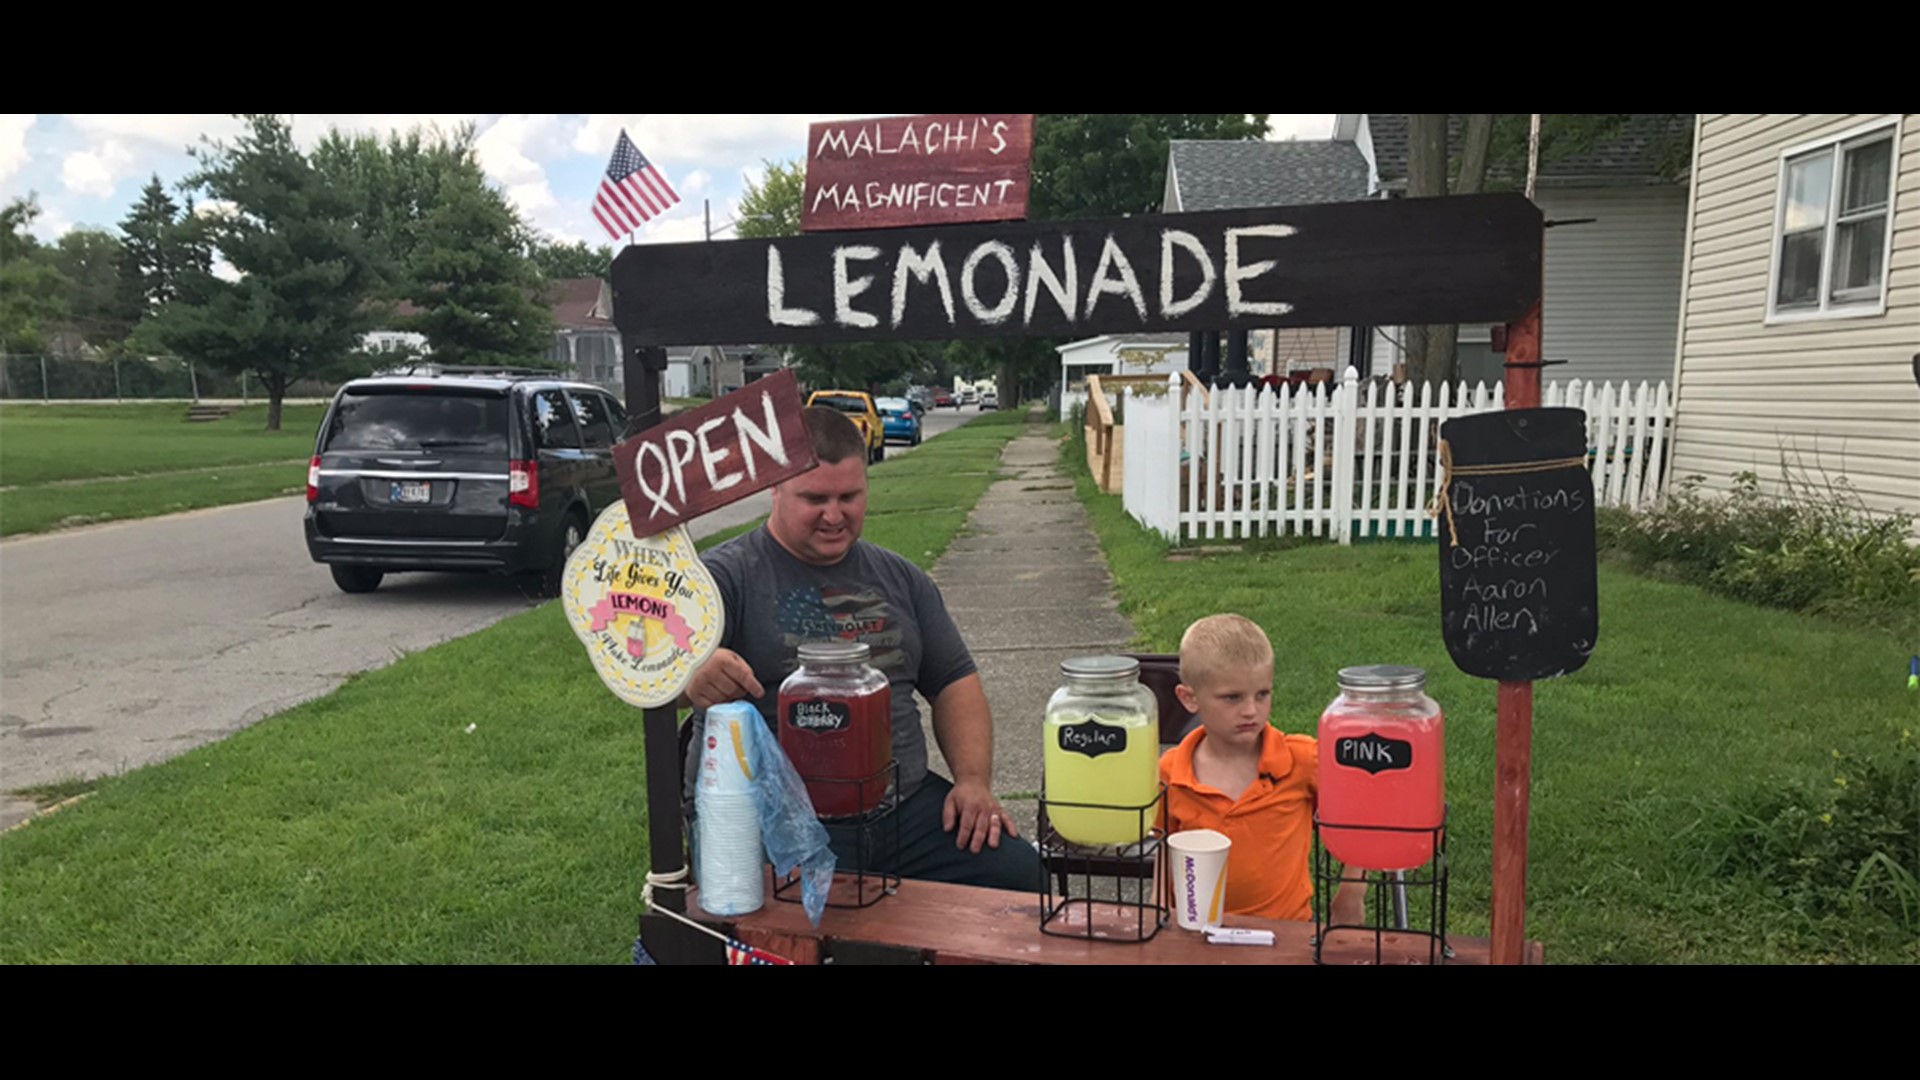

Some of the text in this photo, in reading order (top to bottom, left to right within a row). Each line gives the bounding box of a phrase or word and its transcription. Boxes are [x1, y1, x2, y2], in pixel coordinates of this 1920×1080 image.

[814, 117, 1009, 159] MALACHI'S
[811, 179, 1016, 214] MAGNIFICENT
[766, 223, 1298, 329] LEMONADE
[635, 389, 791, 521] OPEN
[1453, 480, 1586, 515] Donations
[1484, 517, 1538, 544] For
[614, 539, 672, 568] WHEN
[1452, 545, 1562, 569] Officer
[593, 559, 694, 599] Life Gives You
[1462, 575, 1547, 601] Aaron
[611, 593, 668, 619] LEMONS
[1463, 603, 1538, 636] Allen
[601, 632, 629, 665] Make
[1063, 726, 1117, 747] Regular
[1342, 739, 1394, 763] PINK
[1185, 855, 1198, 923] McDonald's
